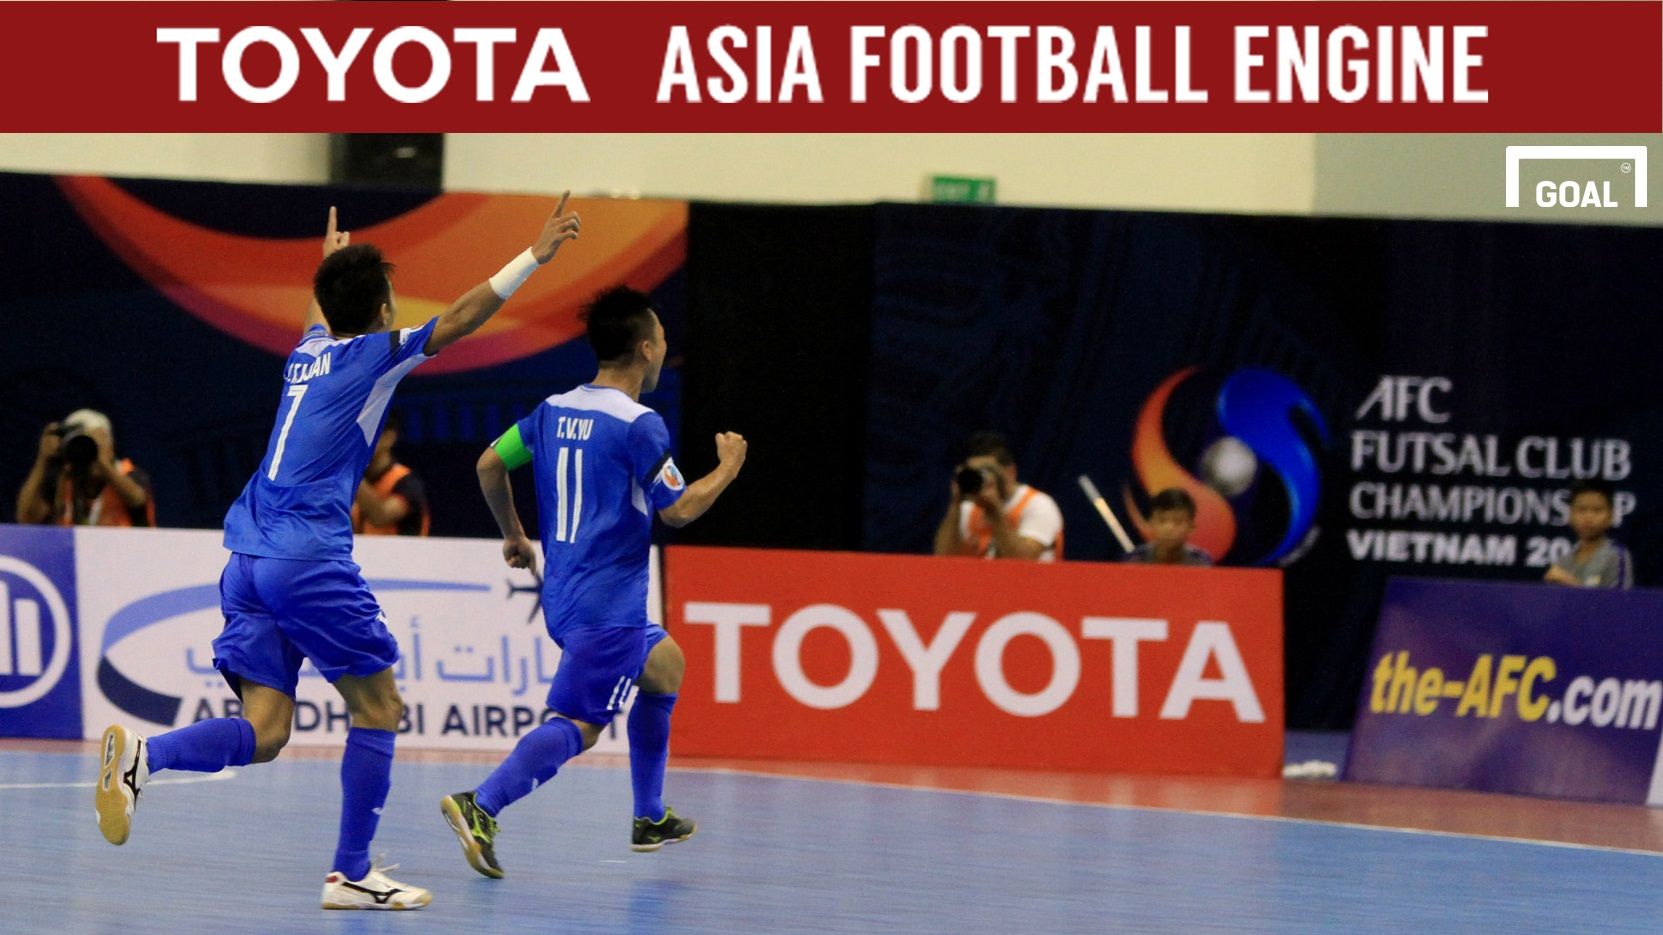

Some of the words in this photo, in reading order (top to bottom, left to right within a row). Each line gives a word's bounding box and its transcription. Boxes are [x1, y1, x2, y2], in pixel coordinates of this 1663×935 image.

[1356, 375, 1452, 424] AFC
[267, 384, 309, 481] 7
[1351, 430, 1510, 477] FUTSAL
[1516, 435, 1632, 481] CLUB
[555, 447, 583, 543] 11
[1350, 481, 1636, 528] CHAMPIONSP
[1347, 529, 1517, 566] VIETNAM
[684, 602, 1266, 724] TOYOTA
[1369, 651, 1663, 730] the-AFC.com
[294, 699, 424, 736] DHBI
